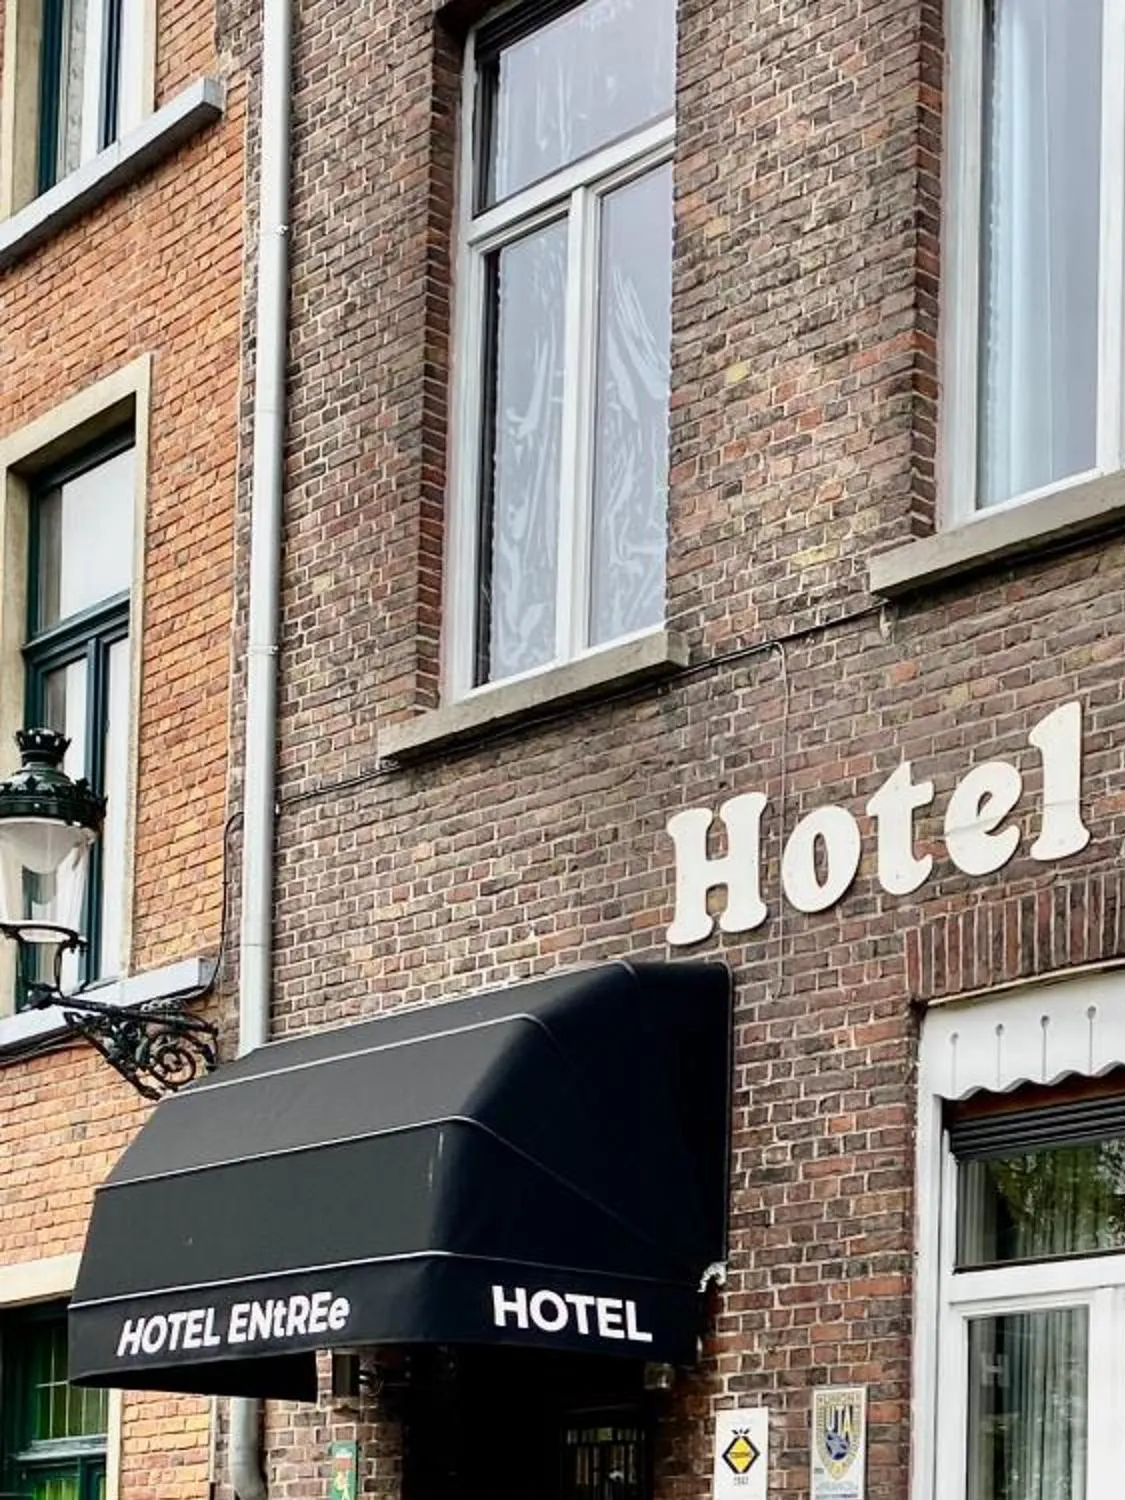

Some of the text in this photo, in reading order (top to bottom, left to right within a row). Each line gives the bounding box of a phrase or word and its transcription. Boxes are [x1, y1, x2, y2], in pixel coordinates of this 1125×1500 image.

[665, 700, 1091, 946] Hotel
[116, 1291, 350, 1357] HOTEL ENtREe
[492, 1285, 653, 1342] HOTEL
